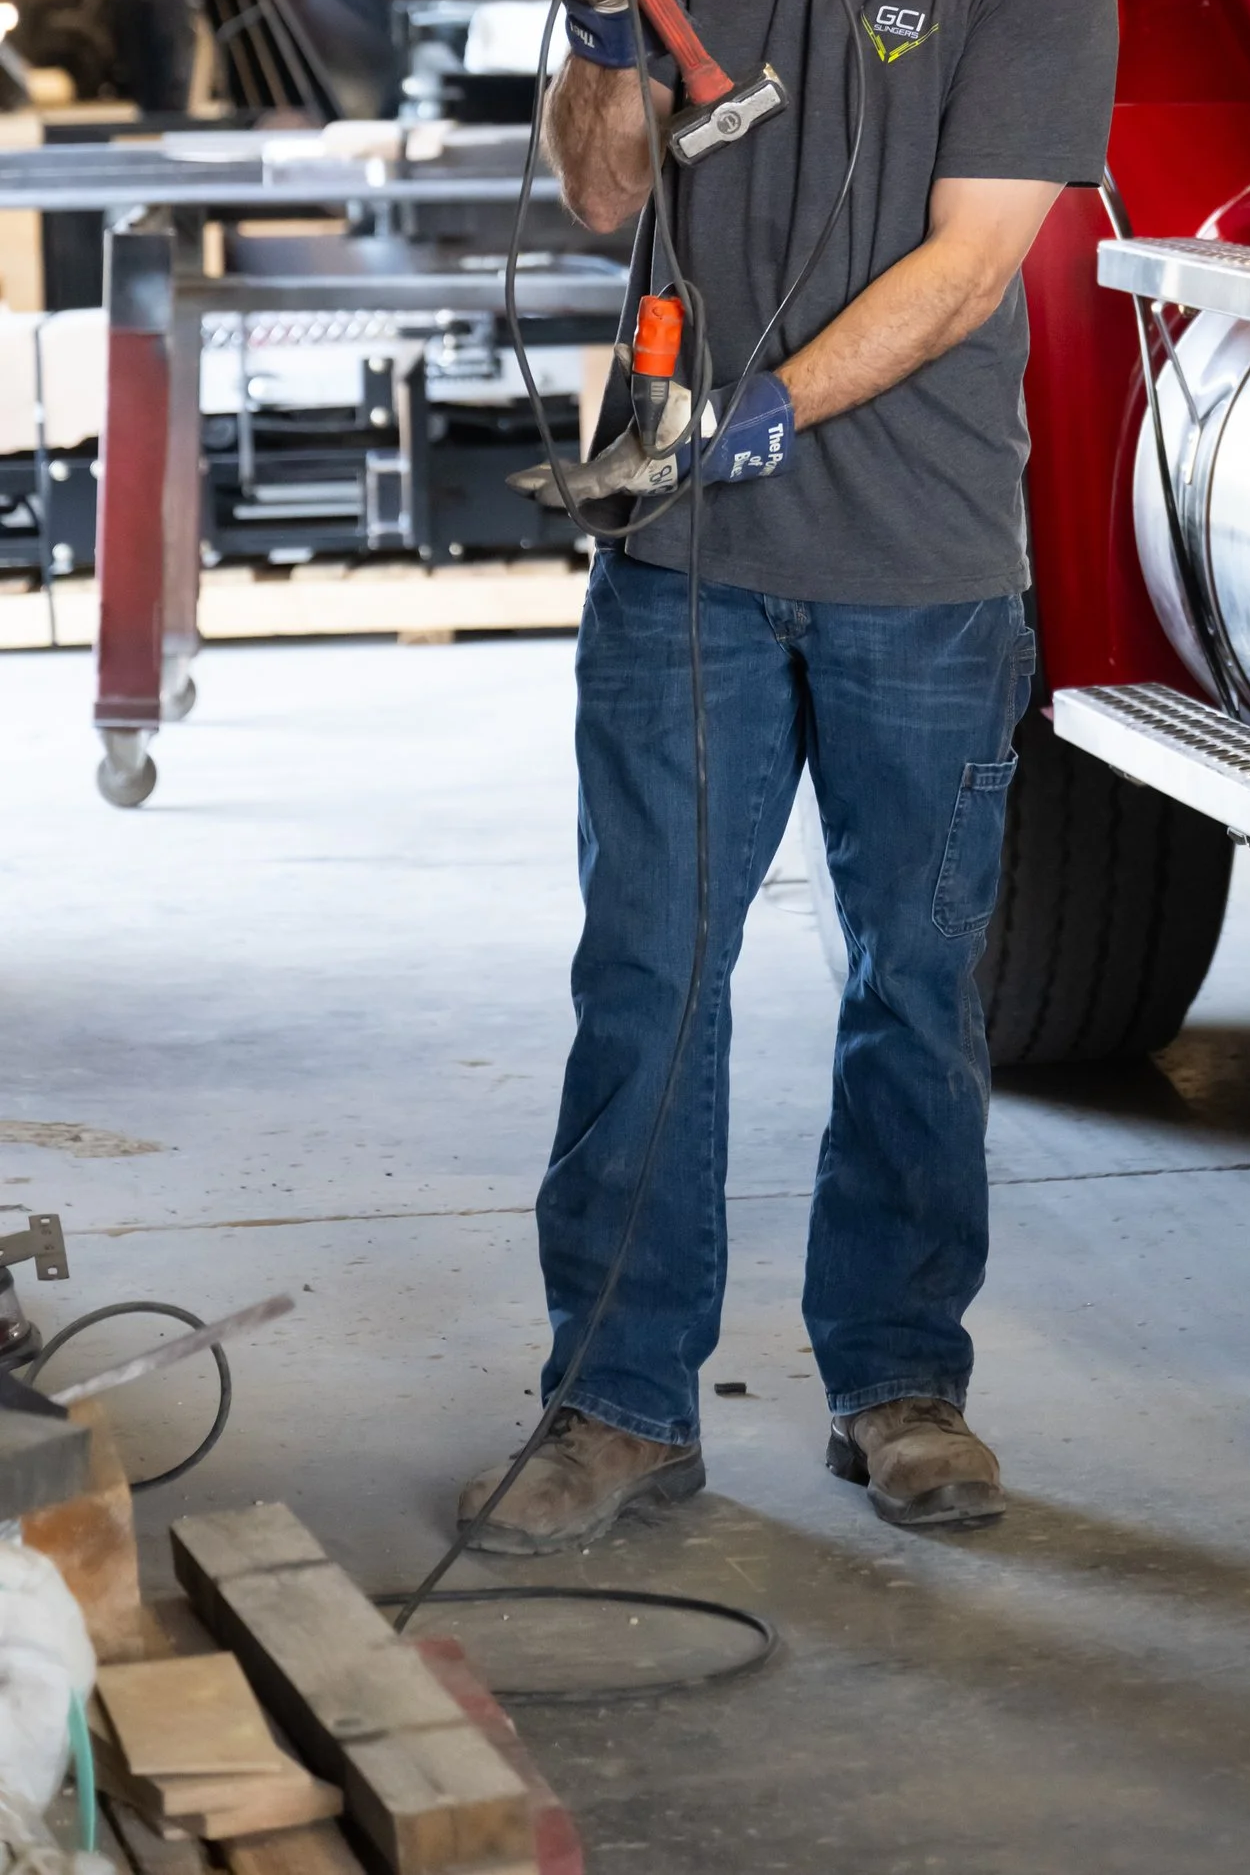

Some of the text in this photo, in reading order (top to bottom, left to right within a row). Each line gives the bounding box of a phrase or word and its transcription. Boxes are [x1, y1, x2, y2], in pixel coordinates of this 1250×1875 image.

[876, 5, 925, 32] GCI
[873, 23, 919, 40] SLINGERS
[768, 423, 784, 453] The
[747, 455, 764, 467] of
